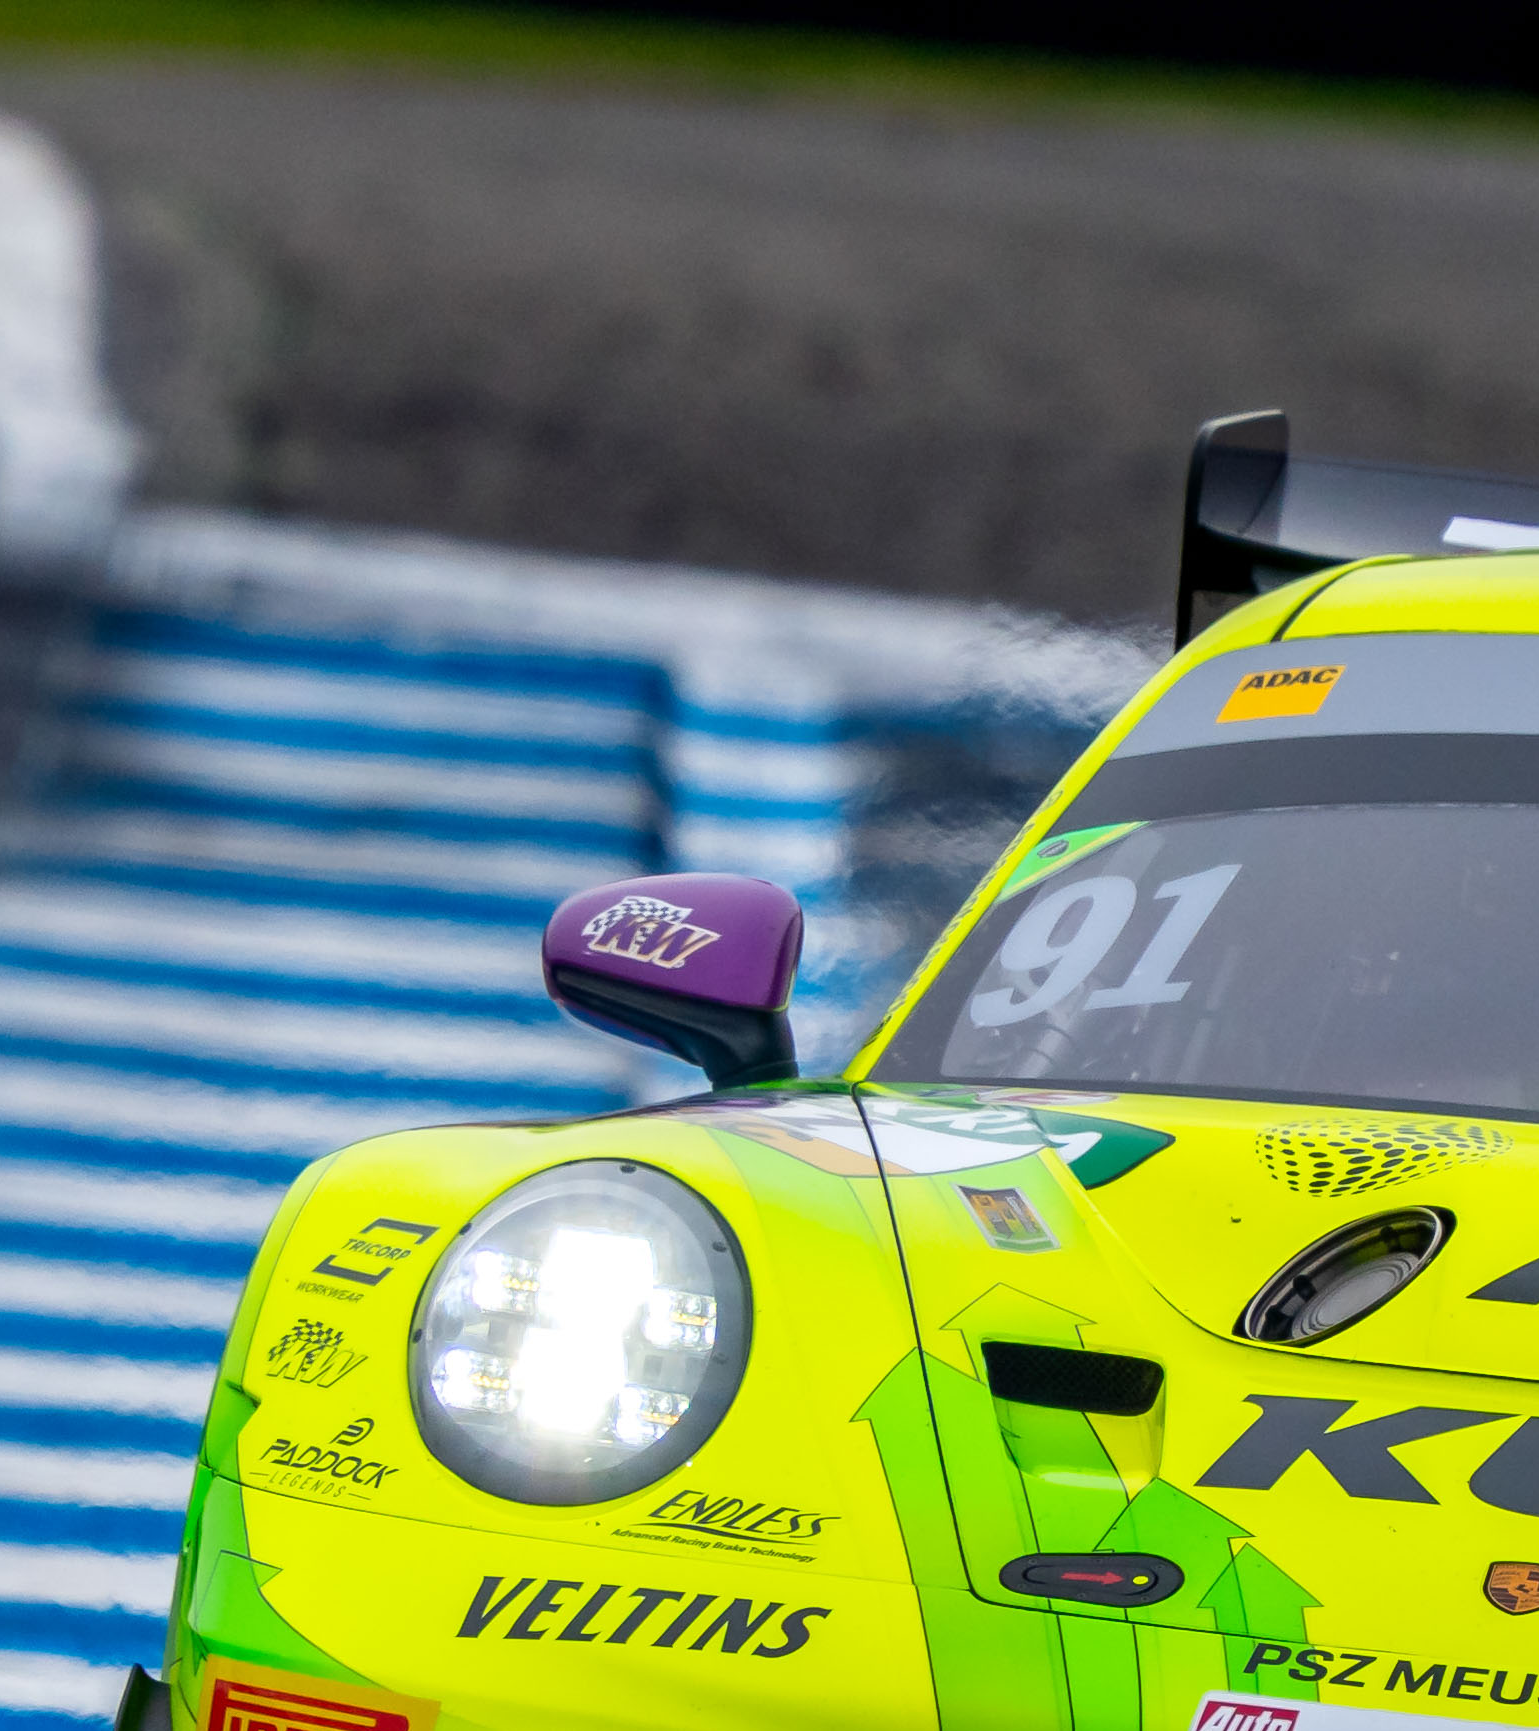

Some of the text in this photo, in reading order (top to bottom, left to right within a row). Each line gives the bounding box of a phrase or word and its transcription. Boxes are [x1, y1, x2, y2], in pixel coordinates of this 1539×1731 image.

[1241, 668, 1338, 692] ADAC
[588, 908, 721, 968] KW
[970, 865, 1242, 1028] 91
[341, 1239, 411, 1261] TRICORP
[296, 1281, 364, 1303] WORKWEAR
[259, 1438, 401, 1489] PADDOCK
[269, 1471, 347, 1498] LEGENDS
[647, 1490, 842, 1539] ENDLESS
[611, 1528, 818, 1563] Advanced Racing Brake Technology
[456, 1576, 833, 1658] VELTINS
[1243, 1643, 1378, 1689] PSZ
